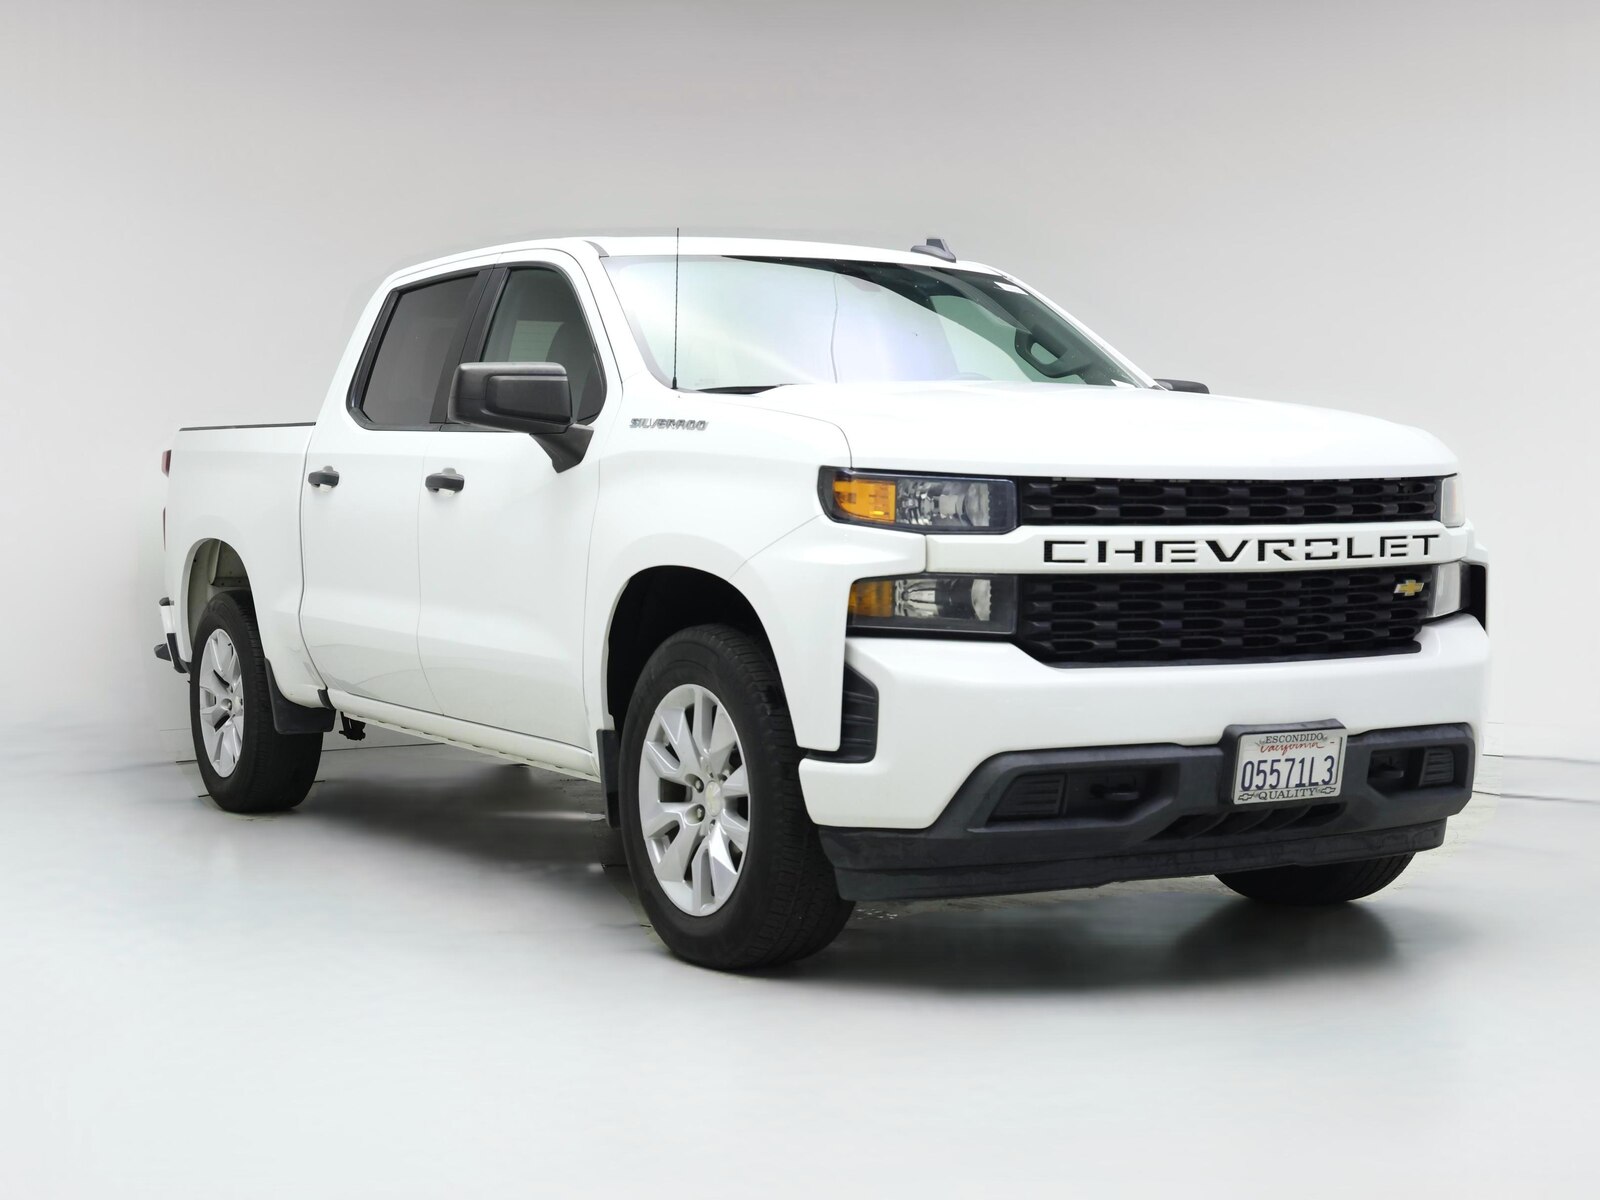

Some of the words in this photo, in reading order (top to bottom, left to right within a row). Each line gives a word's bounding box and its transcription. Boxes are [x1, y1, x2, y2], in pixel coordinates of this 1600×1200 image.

[629, 418, 708, 431] SILVERADO
[1043, 534, 1440, 563] CHEVROLET
[1265, 733, 1324, 744] ESCONDIDO
[1241, 755, 1335, 791] 05571L3
[1258, 788, 1316, 801] QUALITY
